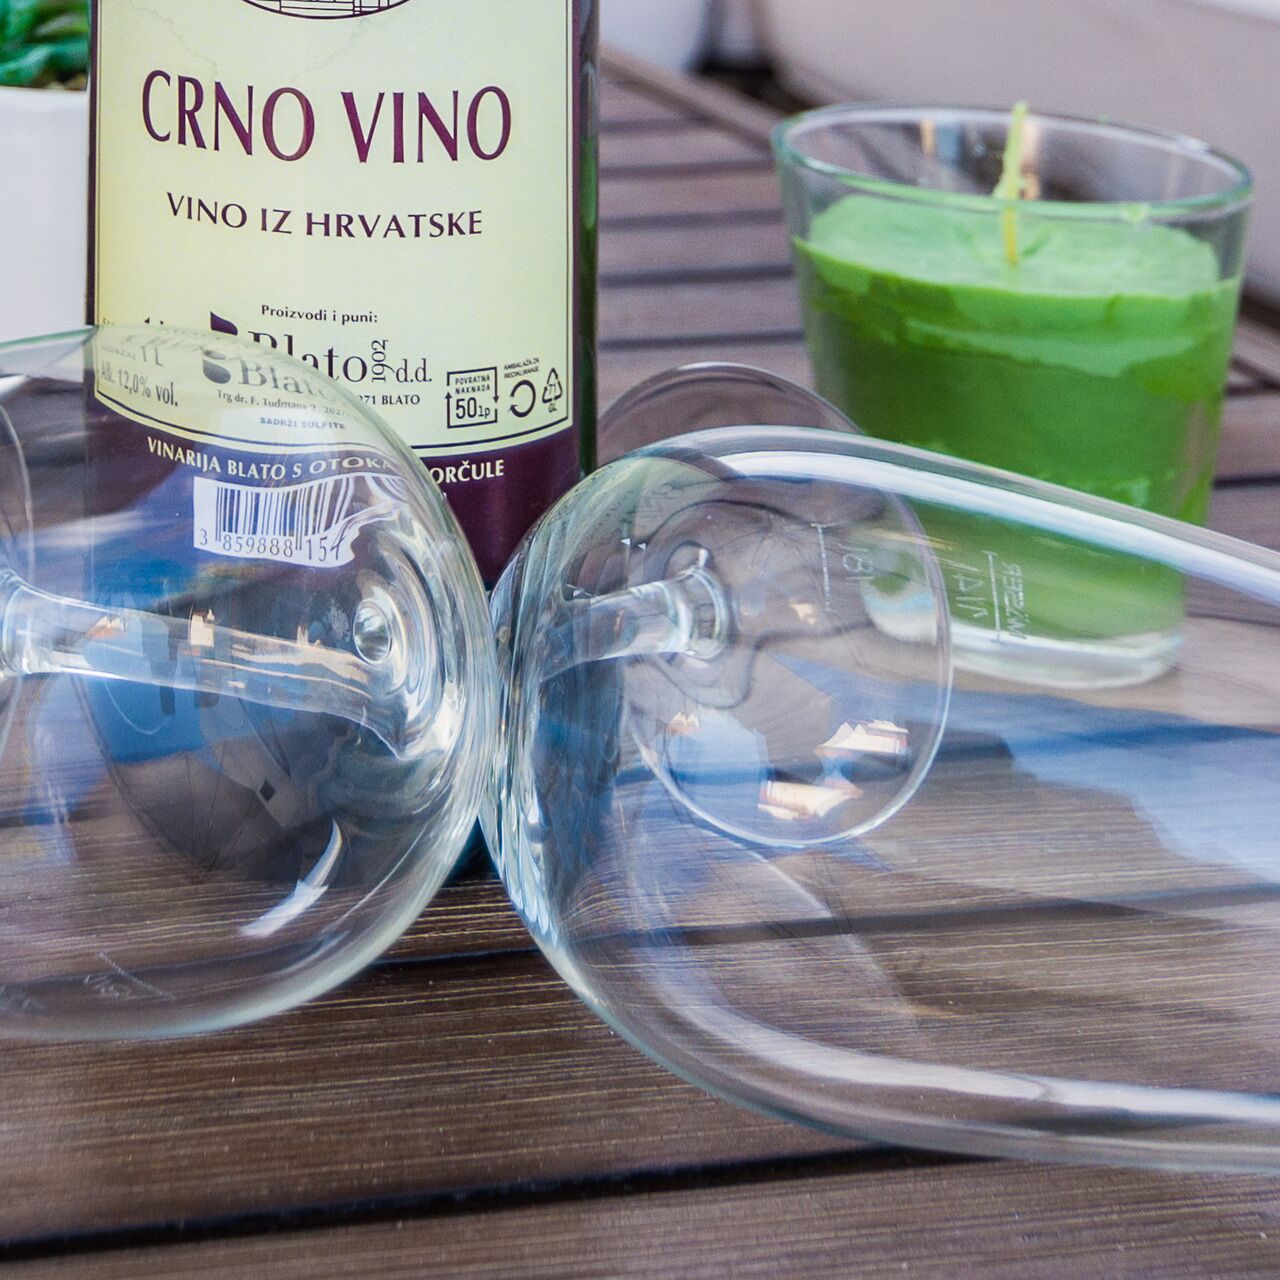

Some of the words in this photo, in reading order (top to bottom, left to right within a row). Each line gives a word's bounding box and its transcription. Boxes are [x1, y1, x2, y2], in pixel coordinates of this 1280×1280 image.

[142, 69, 315, 161] CRNO
[340, 85, 512, 163] VINO
[167, 191, 247, 228] VINO
[261, 207, 292, 234] IZ
[306, 210, 482, 239] HRVATSKE
[261, 304, 327, 321] Proizvodi
[332, 310, 336, 321] i
[342, 310, 378, 325] puni:
[370, 339, 396, 383] 1902
[396, 358, 432, 383] d.d.
[118, 367, 152, 399] 12,0%
[155, 381, 179, 407] vol.
[455, 374, 491, 386] POVRATNA
[455, 384, 491, 395] NAKNADA
[216, 389, 232, 403] Trg
[234, 394, 247, 404] dr.
[250, 396, 259, 406] F.
[381, 394, 420, 405] BLATO
[147, 436, 221, 473] VINARIJA
[227, 459, 286, 481] BLATO
[292, 463, 302, 478] S
[427, 459, 505, 484] ORČULE
[199, 528, 209, 546] 3
[222, 535, 293, 559] 859888
